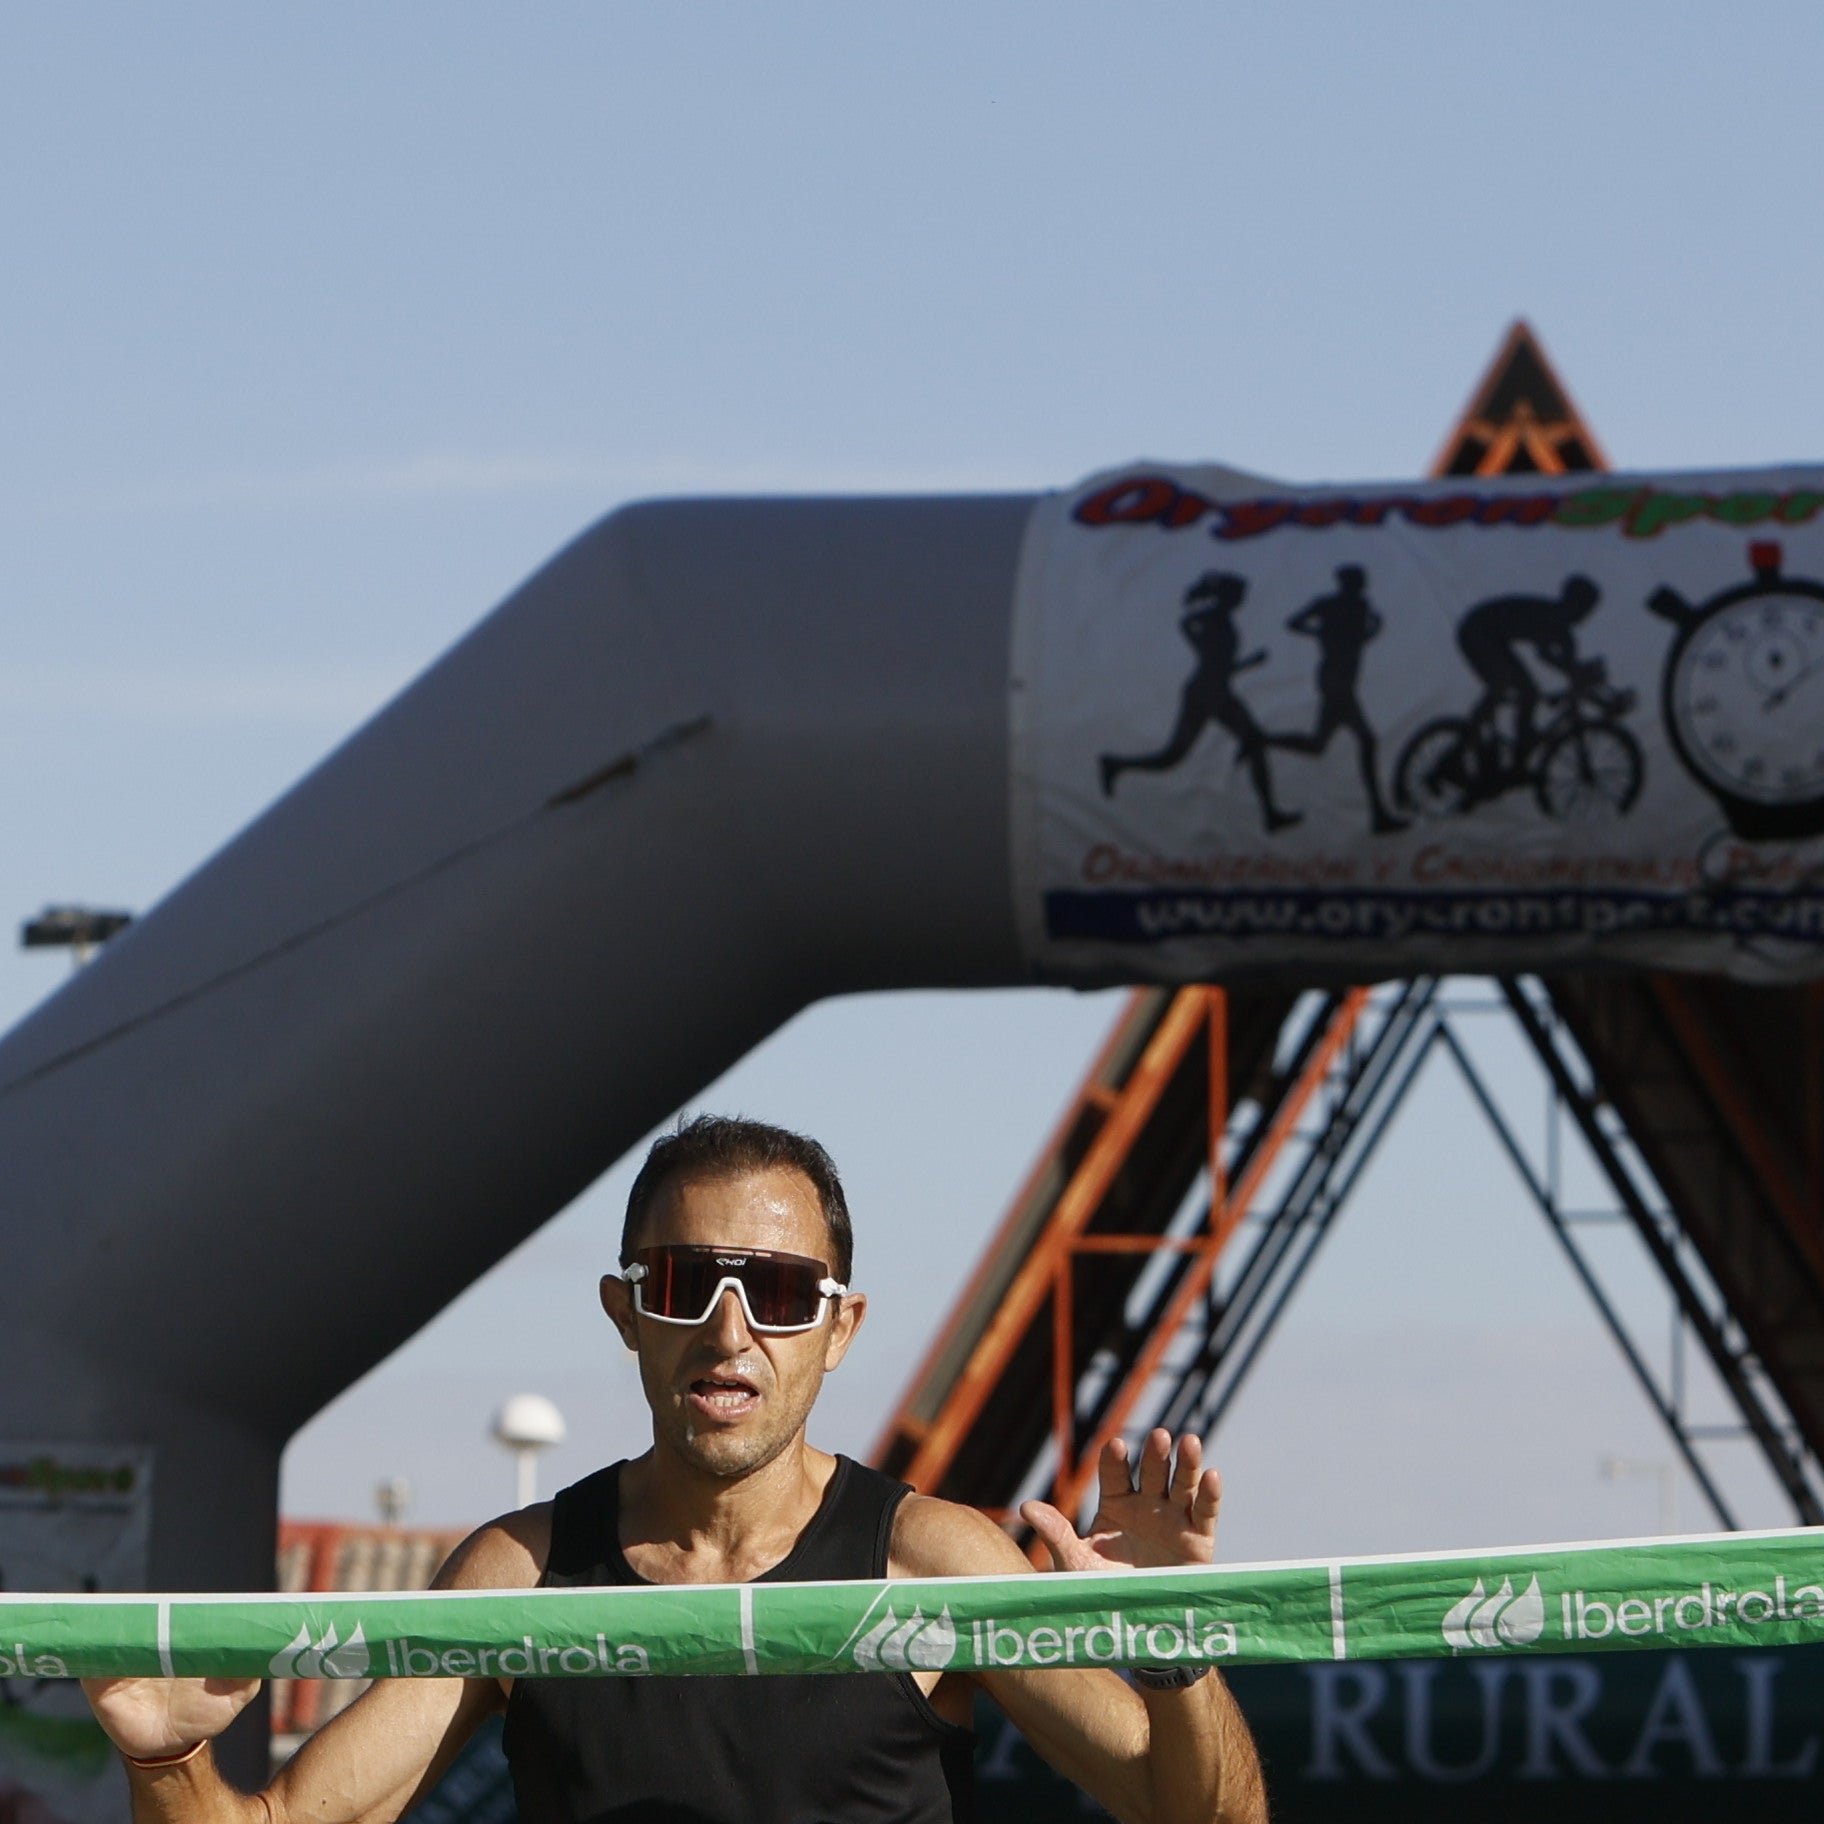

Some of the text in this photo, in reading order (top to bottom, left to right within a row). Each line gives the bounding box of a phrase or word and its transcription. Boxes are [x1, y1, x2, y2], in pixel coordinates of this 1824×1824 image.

[386, 1633, 650, 1677] Iberdrola
[973, 1608, 1239, 1667] Iberdrola
[1299, 1657, 1819, 1783] RURAL
